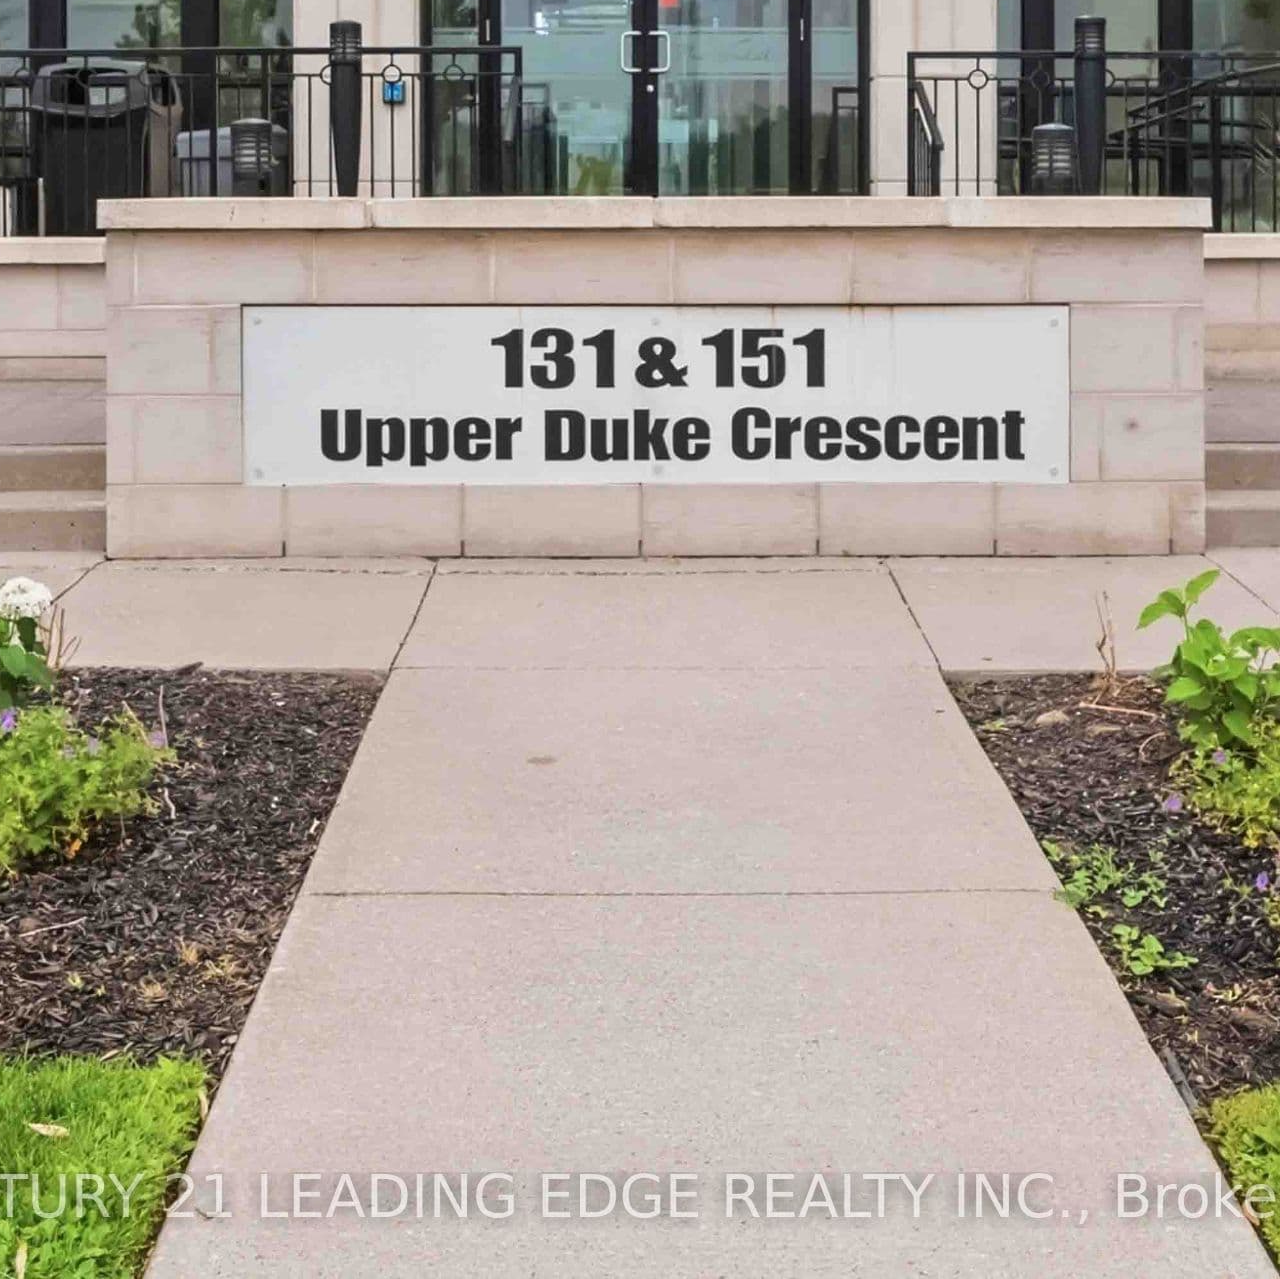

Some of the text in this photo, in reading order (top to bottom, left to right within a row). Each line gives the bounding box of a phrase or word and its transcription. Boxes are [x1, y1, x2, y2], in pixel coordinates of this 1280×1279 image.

[491, 328, 825, 389] 131 & 151
[320, 406, 1025, 467] Upper Duke Crescent
